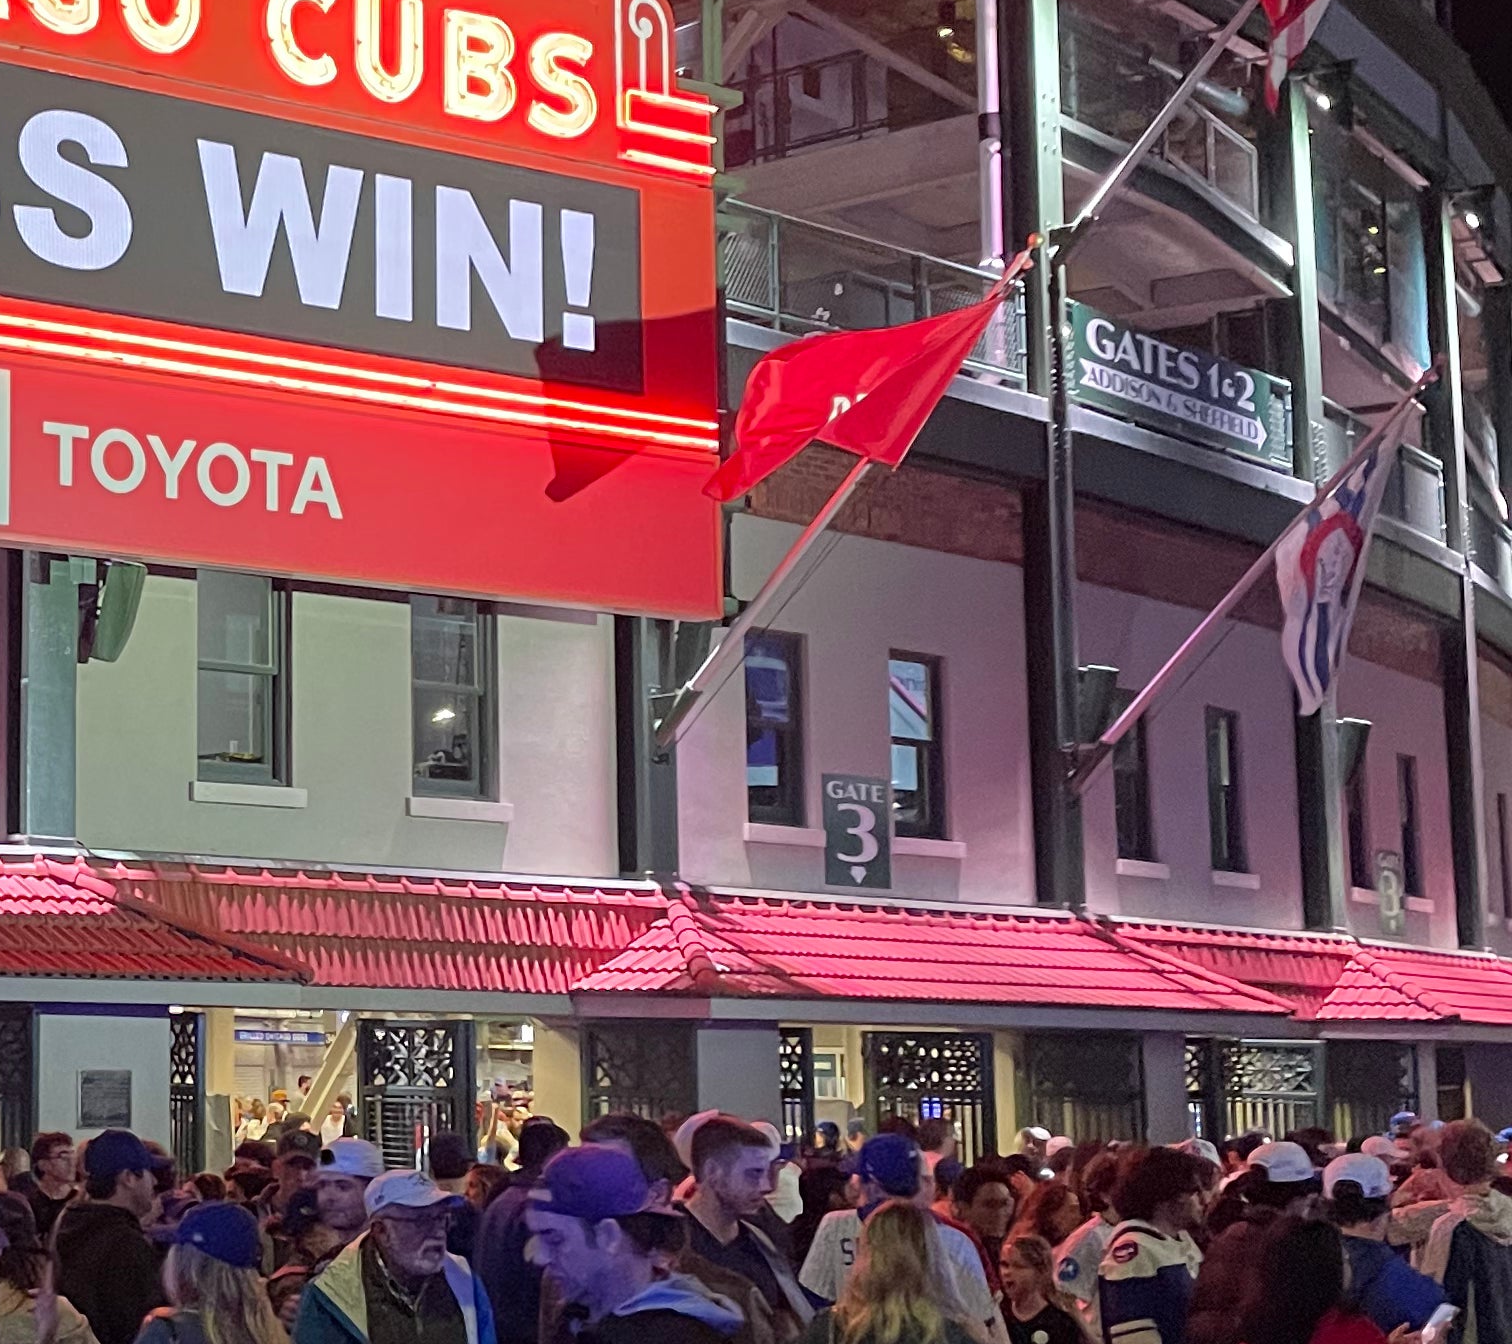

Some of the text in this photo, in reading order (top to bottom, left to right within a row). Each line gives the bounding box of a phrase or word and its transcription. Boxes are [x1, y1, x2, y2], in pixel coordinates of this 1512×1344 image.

[198, 138, 597, 352] WIN!
[1085, 317, 1200, 390] GATES
[1087, 366, 1161, 406] ADDISON
[1182, 400, 1259, 441] SHEFFIELD
[43, 419, 345, 521] TOYOTA
[826, 780, 886, 804] GATE
[836, 802, 879, 863] 3
